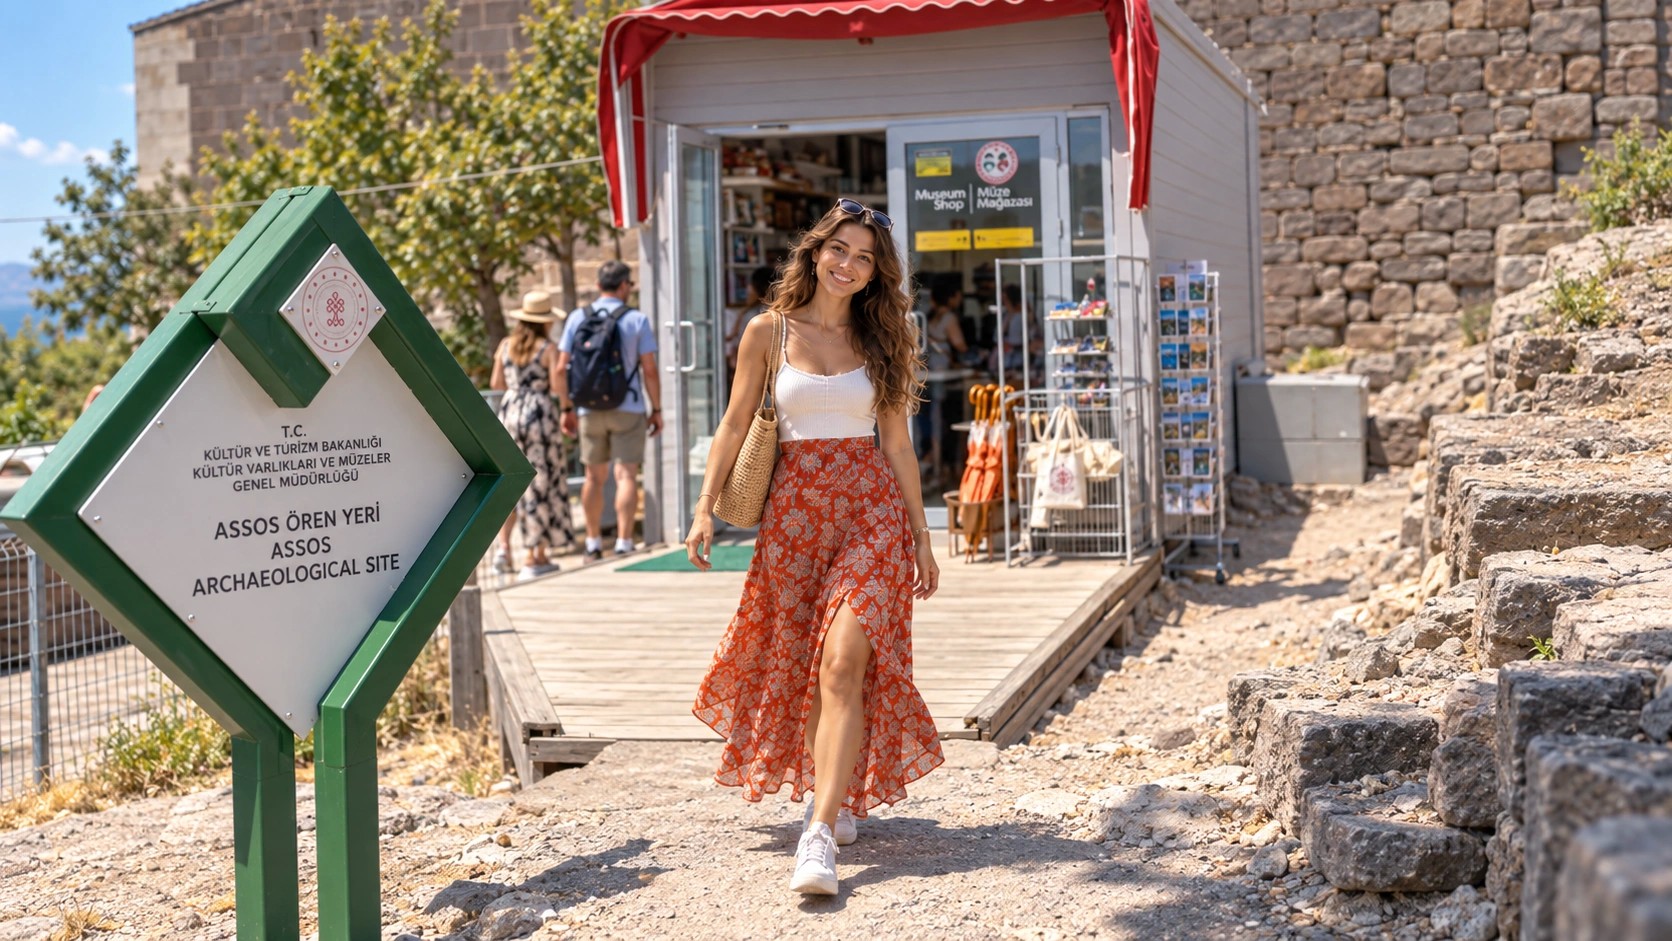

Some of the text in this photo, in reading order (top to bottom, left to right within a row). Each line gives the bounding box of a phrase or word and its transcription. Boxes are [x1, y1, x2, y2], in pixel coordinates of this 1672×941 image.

[915, 189, 966, 201] Museum
[977, 186, 1011, 197] Müze
[934, 200, 965, 212] Shop
[977, 197, 1033, 211] Mağazası
[281, 425, 306, 439] T.C.
[204, 445, 252, 461] KÜLTÜR
[255, 445, 271, 458] VE
[322, 435, 382, 453] BAKANLIĞI
[193, 463, 244, 480] KÜLTÜR
[247, 458, 318, 475] VARLIKLARI
[320, 457, 335, 469] VE
[233, 468, 359, 492] GENEL MÜDÜRLÜĞÜ
[215, 501, 381, 541] ASSOS ÖREN YERİ
[271, 536, 332, 560] ASSOS
[192, 553, 401, 597] ARCHAEOLOGICAL SITE
